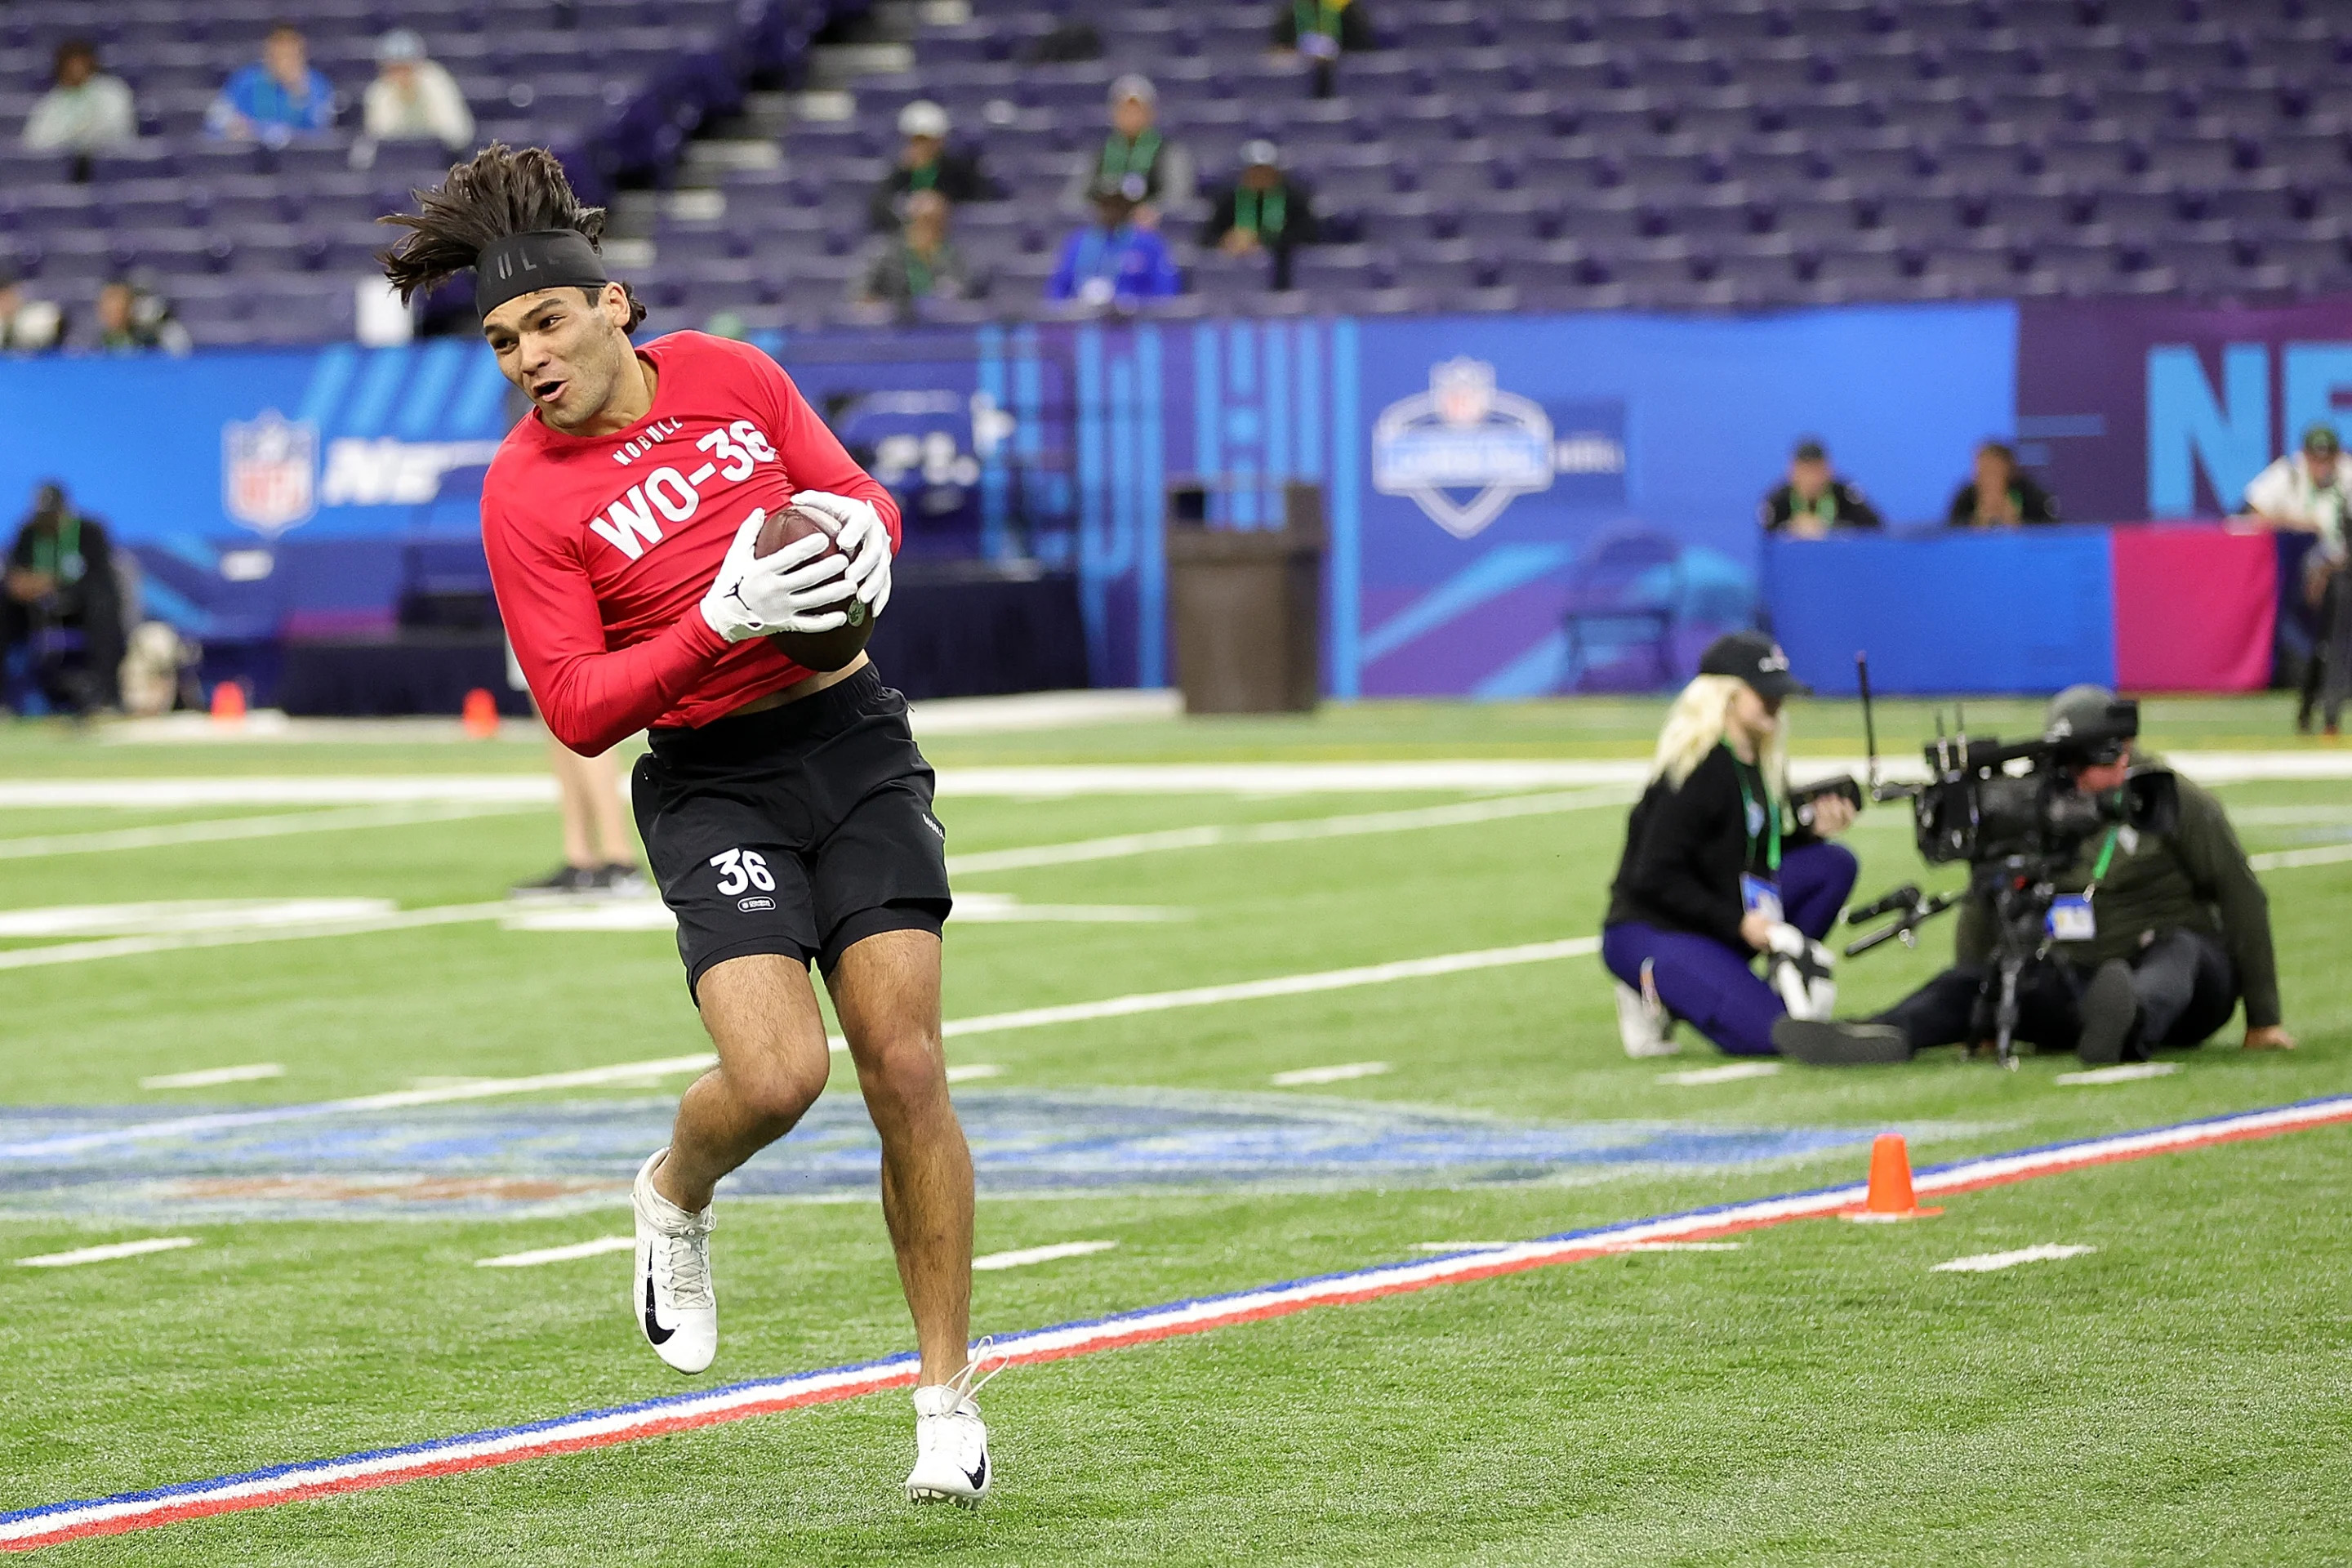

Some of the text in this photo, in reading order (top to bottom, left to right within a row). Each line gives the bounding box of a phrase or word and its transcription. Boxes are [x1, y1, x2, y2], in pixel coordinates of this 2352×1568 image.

[612, 416, 684, 466] NOBULL
[589, 420, 777, 560] WO-36
[710, 848, 776, 895] 36
